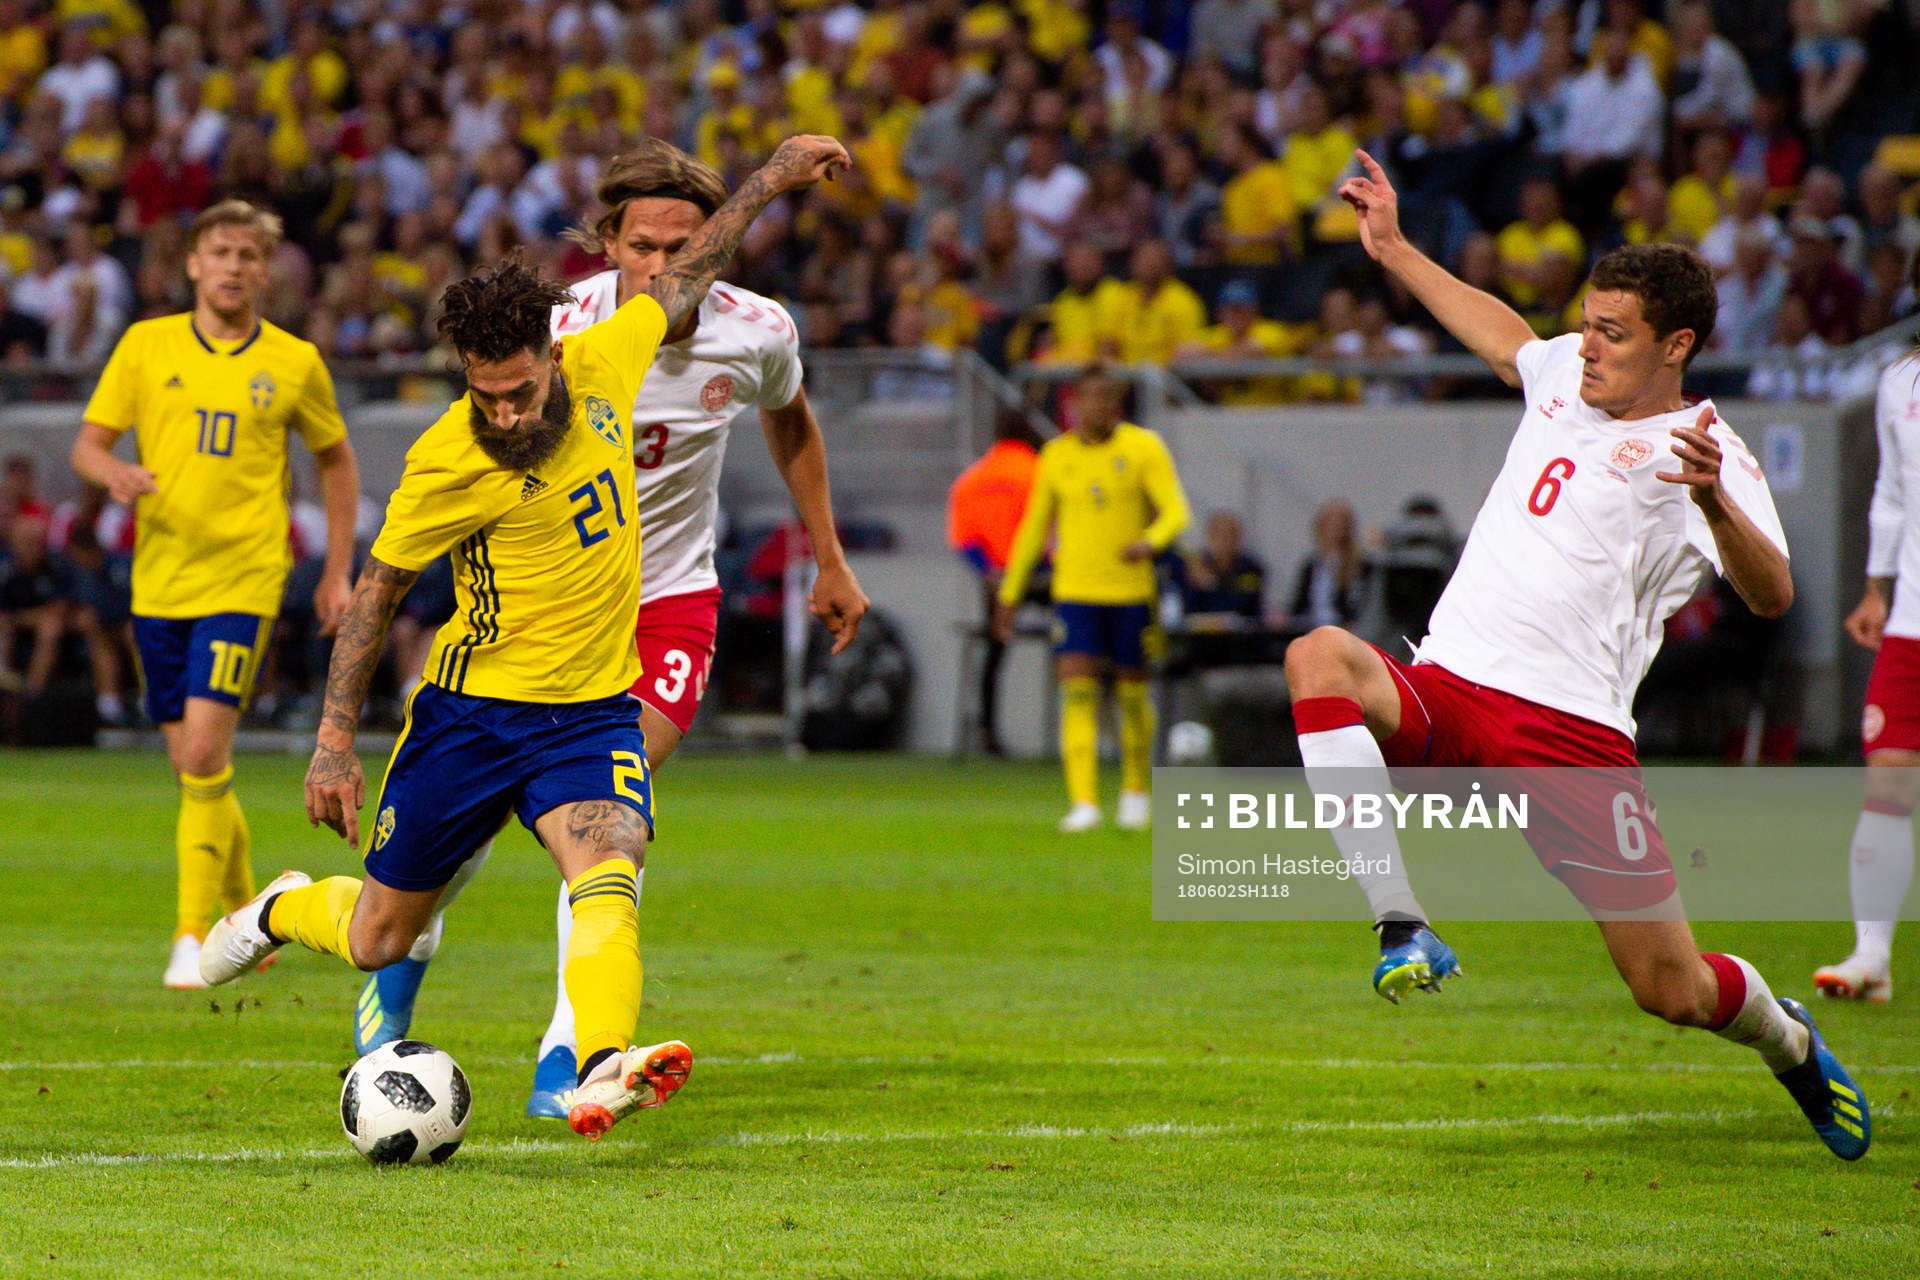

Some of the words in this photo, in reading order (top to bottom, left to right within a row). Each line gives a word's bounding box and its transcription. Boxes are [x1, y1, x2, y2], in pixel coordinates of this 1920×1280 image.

[195, 408, 236, 457] 10
[634, 423, 669, 470] 3
[521, 480, 549, 501] adidas
[568, 468, 626, 549] 21
[1528, 457, 1576, 517] 6
[209, 640, 250, 694] 10
[655, 649, 692, 704] 3
[611, 750, 650, 805] 2
[1612, 791, 1647, 860] 6
